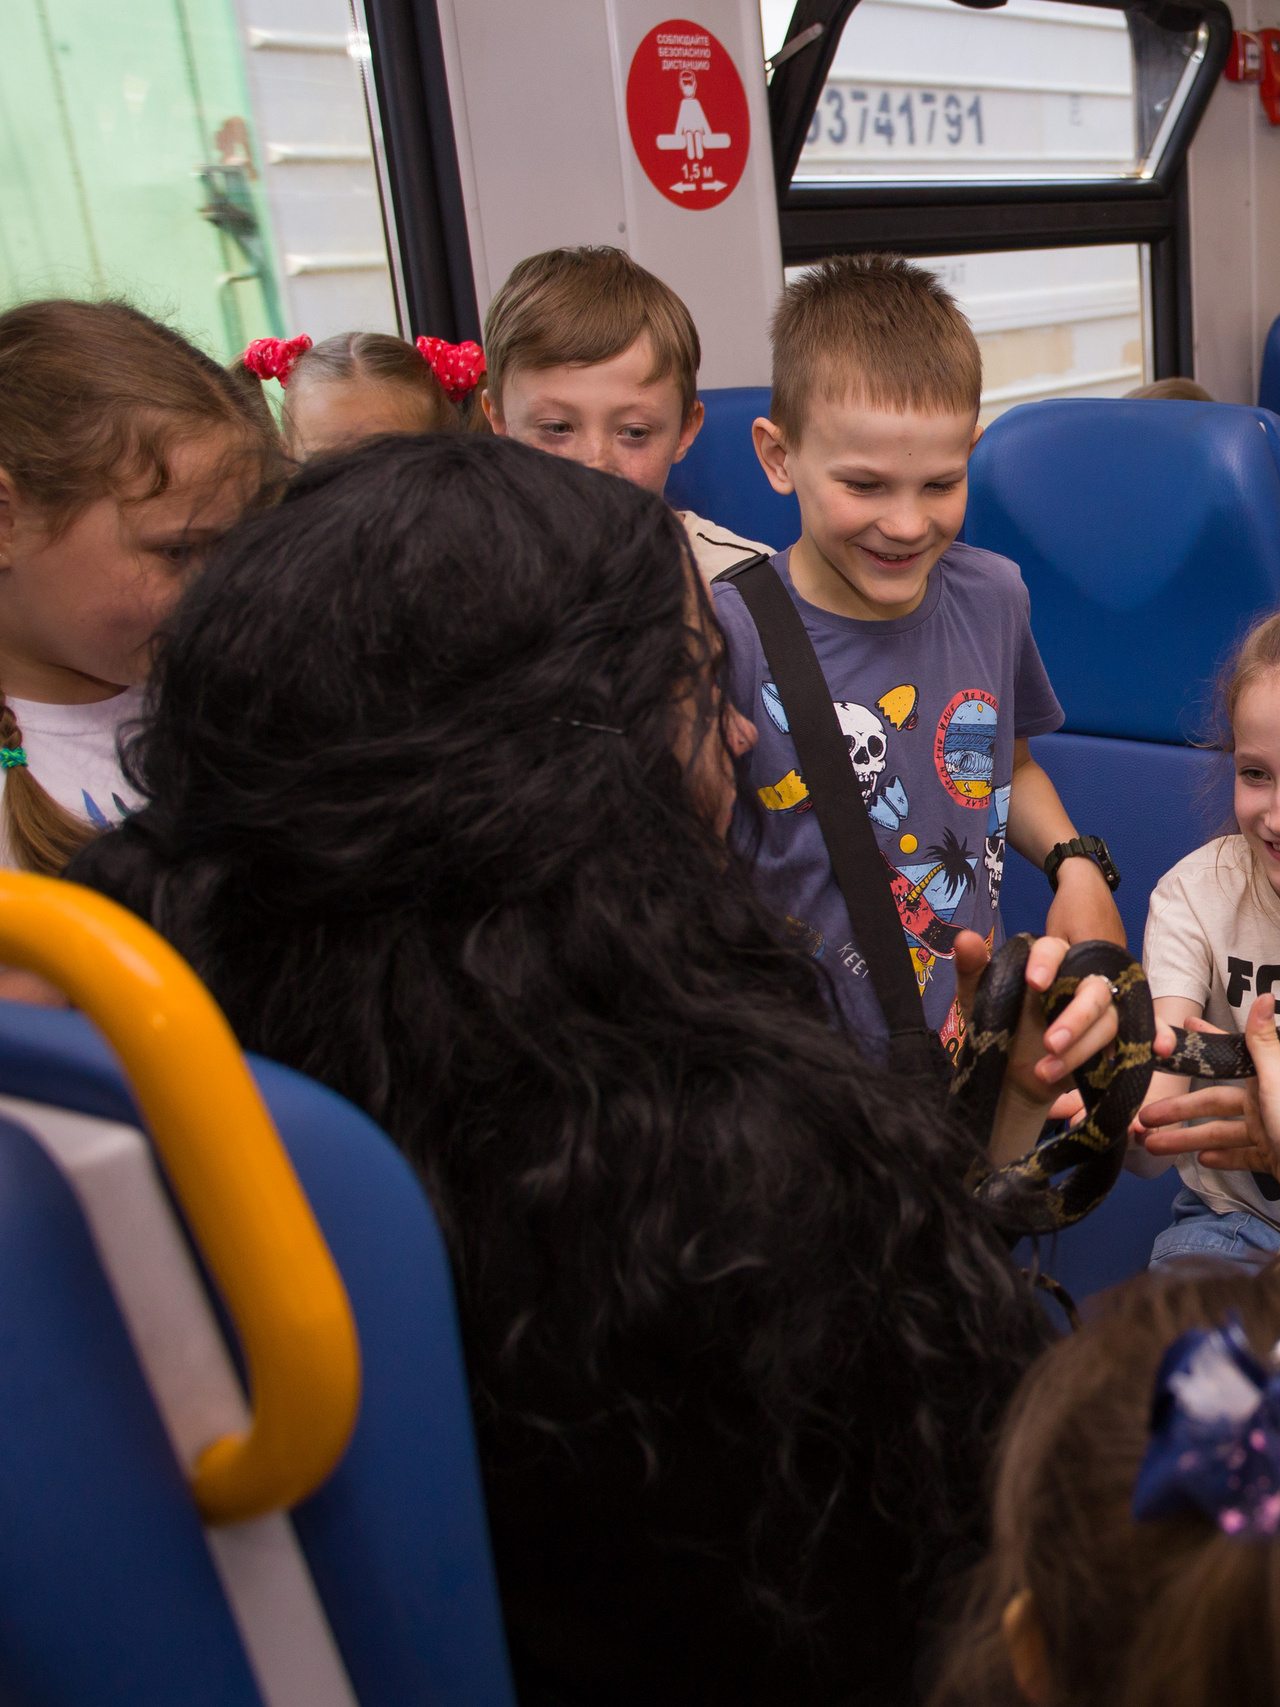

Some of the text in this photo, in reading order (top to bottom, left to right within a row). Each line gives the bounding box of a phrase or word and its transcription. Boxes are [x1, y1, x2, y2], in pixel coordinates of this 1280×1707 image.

[657, 34, 710, 46] СОБЛЮДАЙТЕ
[658, 47, 711, 58] БЕЗОПАСНУЮ
[662, 60, 710, 71] ДИСТАНЦИЮ
[681, 163, 700, 181] 1,5
